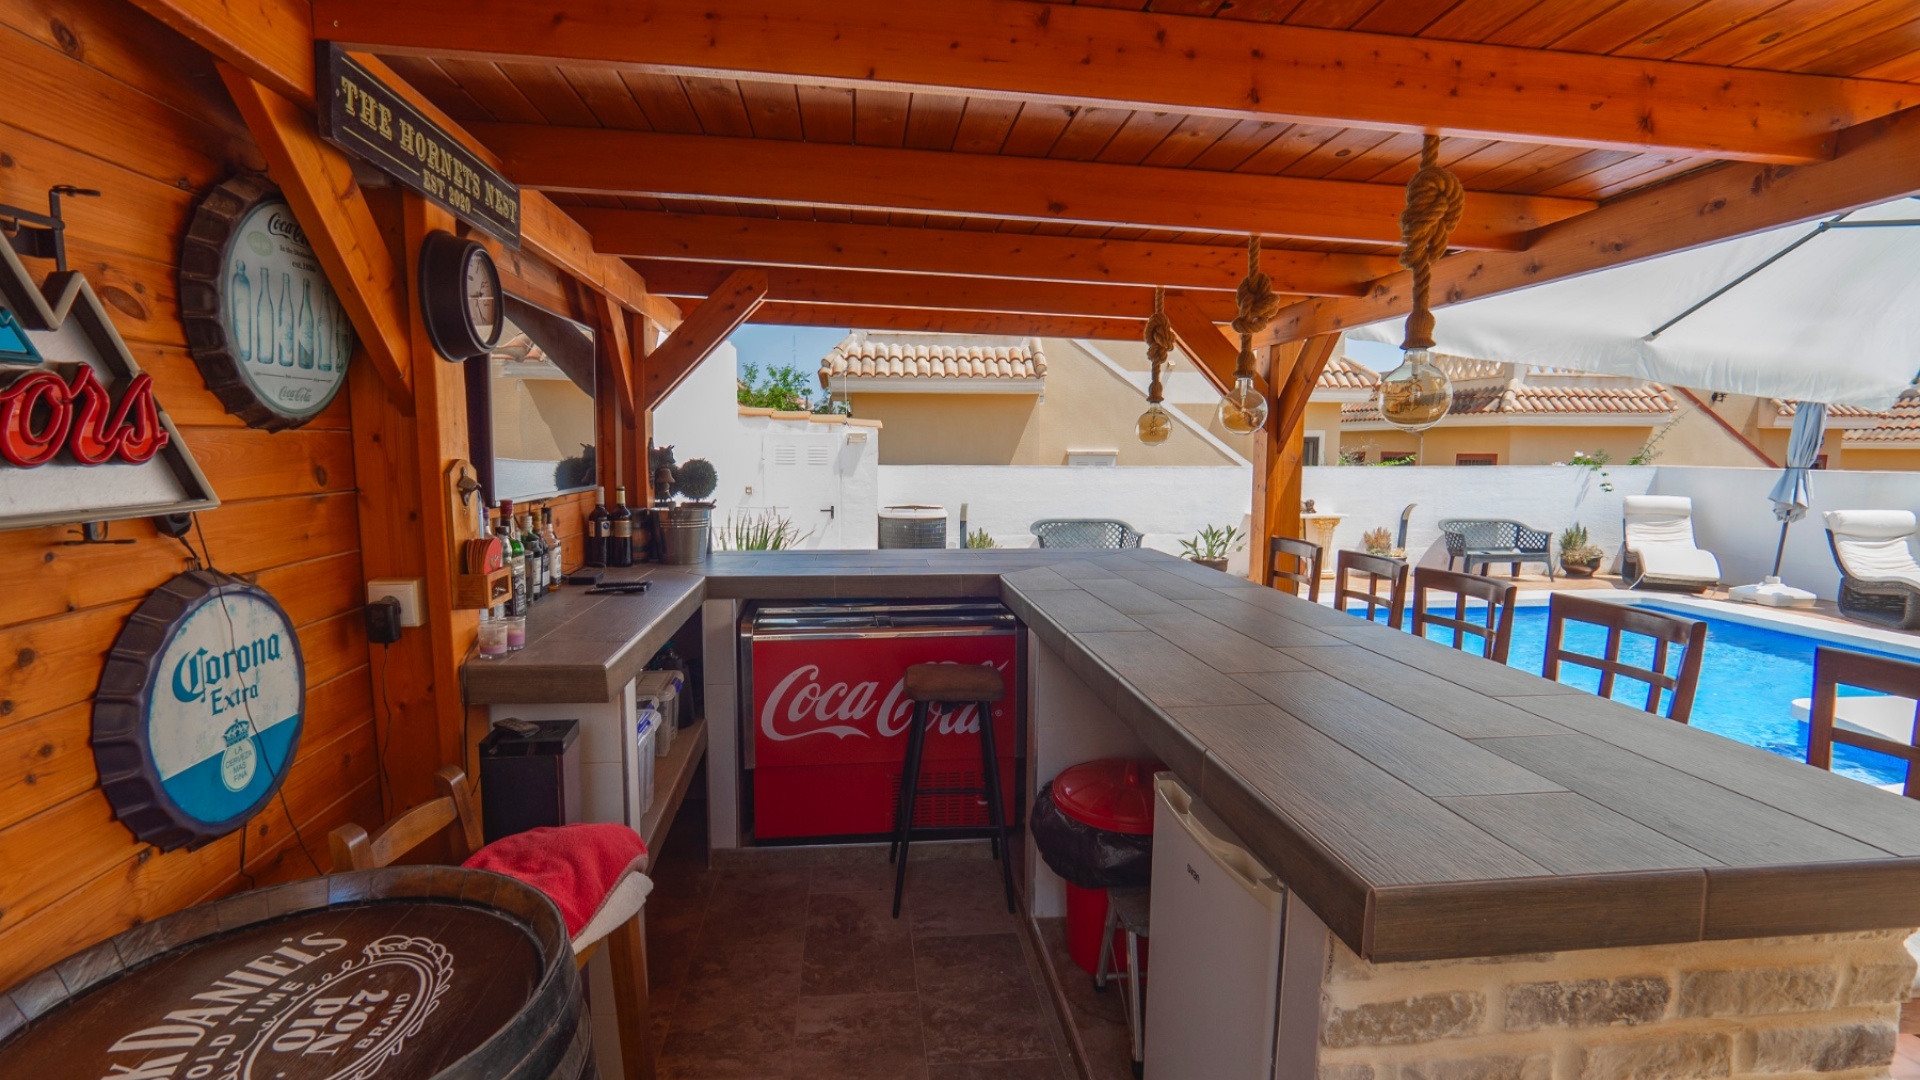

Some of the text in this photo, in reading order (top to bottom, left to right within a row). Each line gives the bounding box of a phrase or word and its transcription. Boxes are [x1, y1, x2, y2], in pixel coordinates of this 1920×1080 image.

[341, 76, 517, 224] THE HORNETS NEST
[423, 168, 471, 215] EST 2020
[0, 362, 169, 468] ors
[172, 633, 281, 703] Corona
[210, 684, 259, 716] Extra
[234, 745, 243, 755] LA
[107, 932, 348, 1053] DANIEL'S
[272, 996, 353, 1052] Old
[354, 993, 411, 1049] BRAND
[186, 1034, 237, 1079] OLD
[229, 981, 304, 1025] TIME
